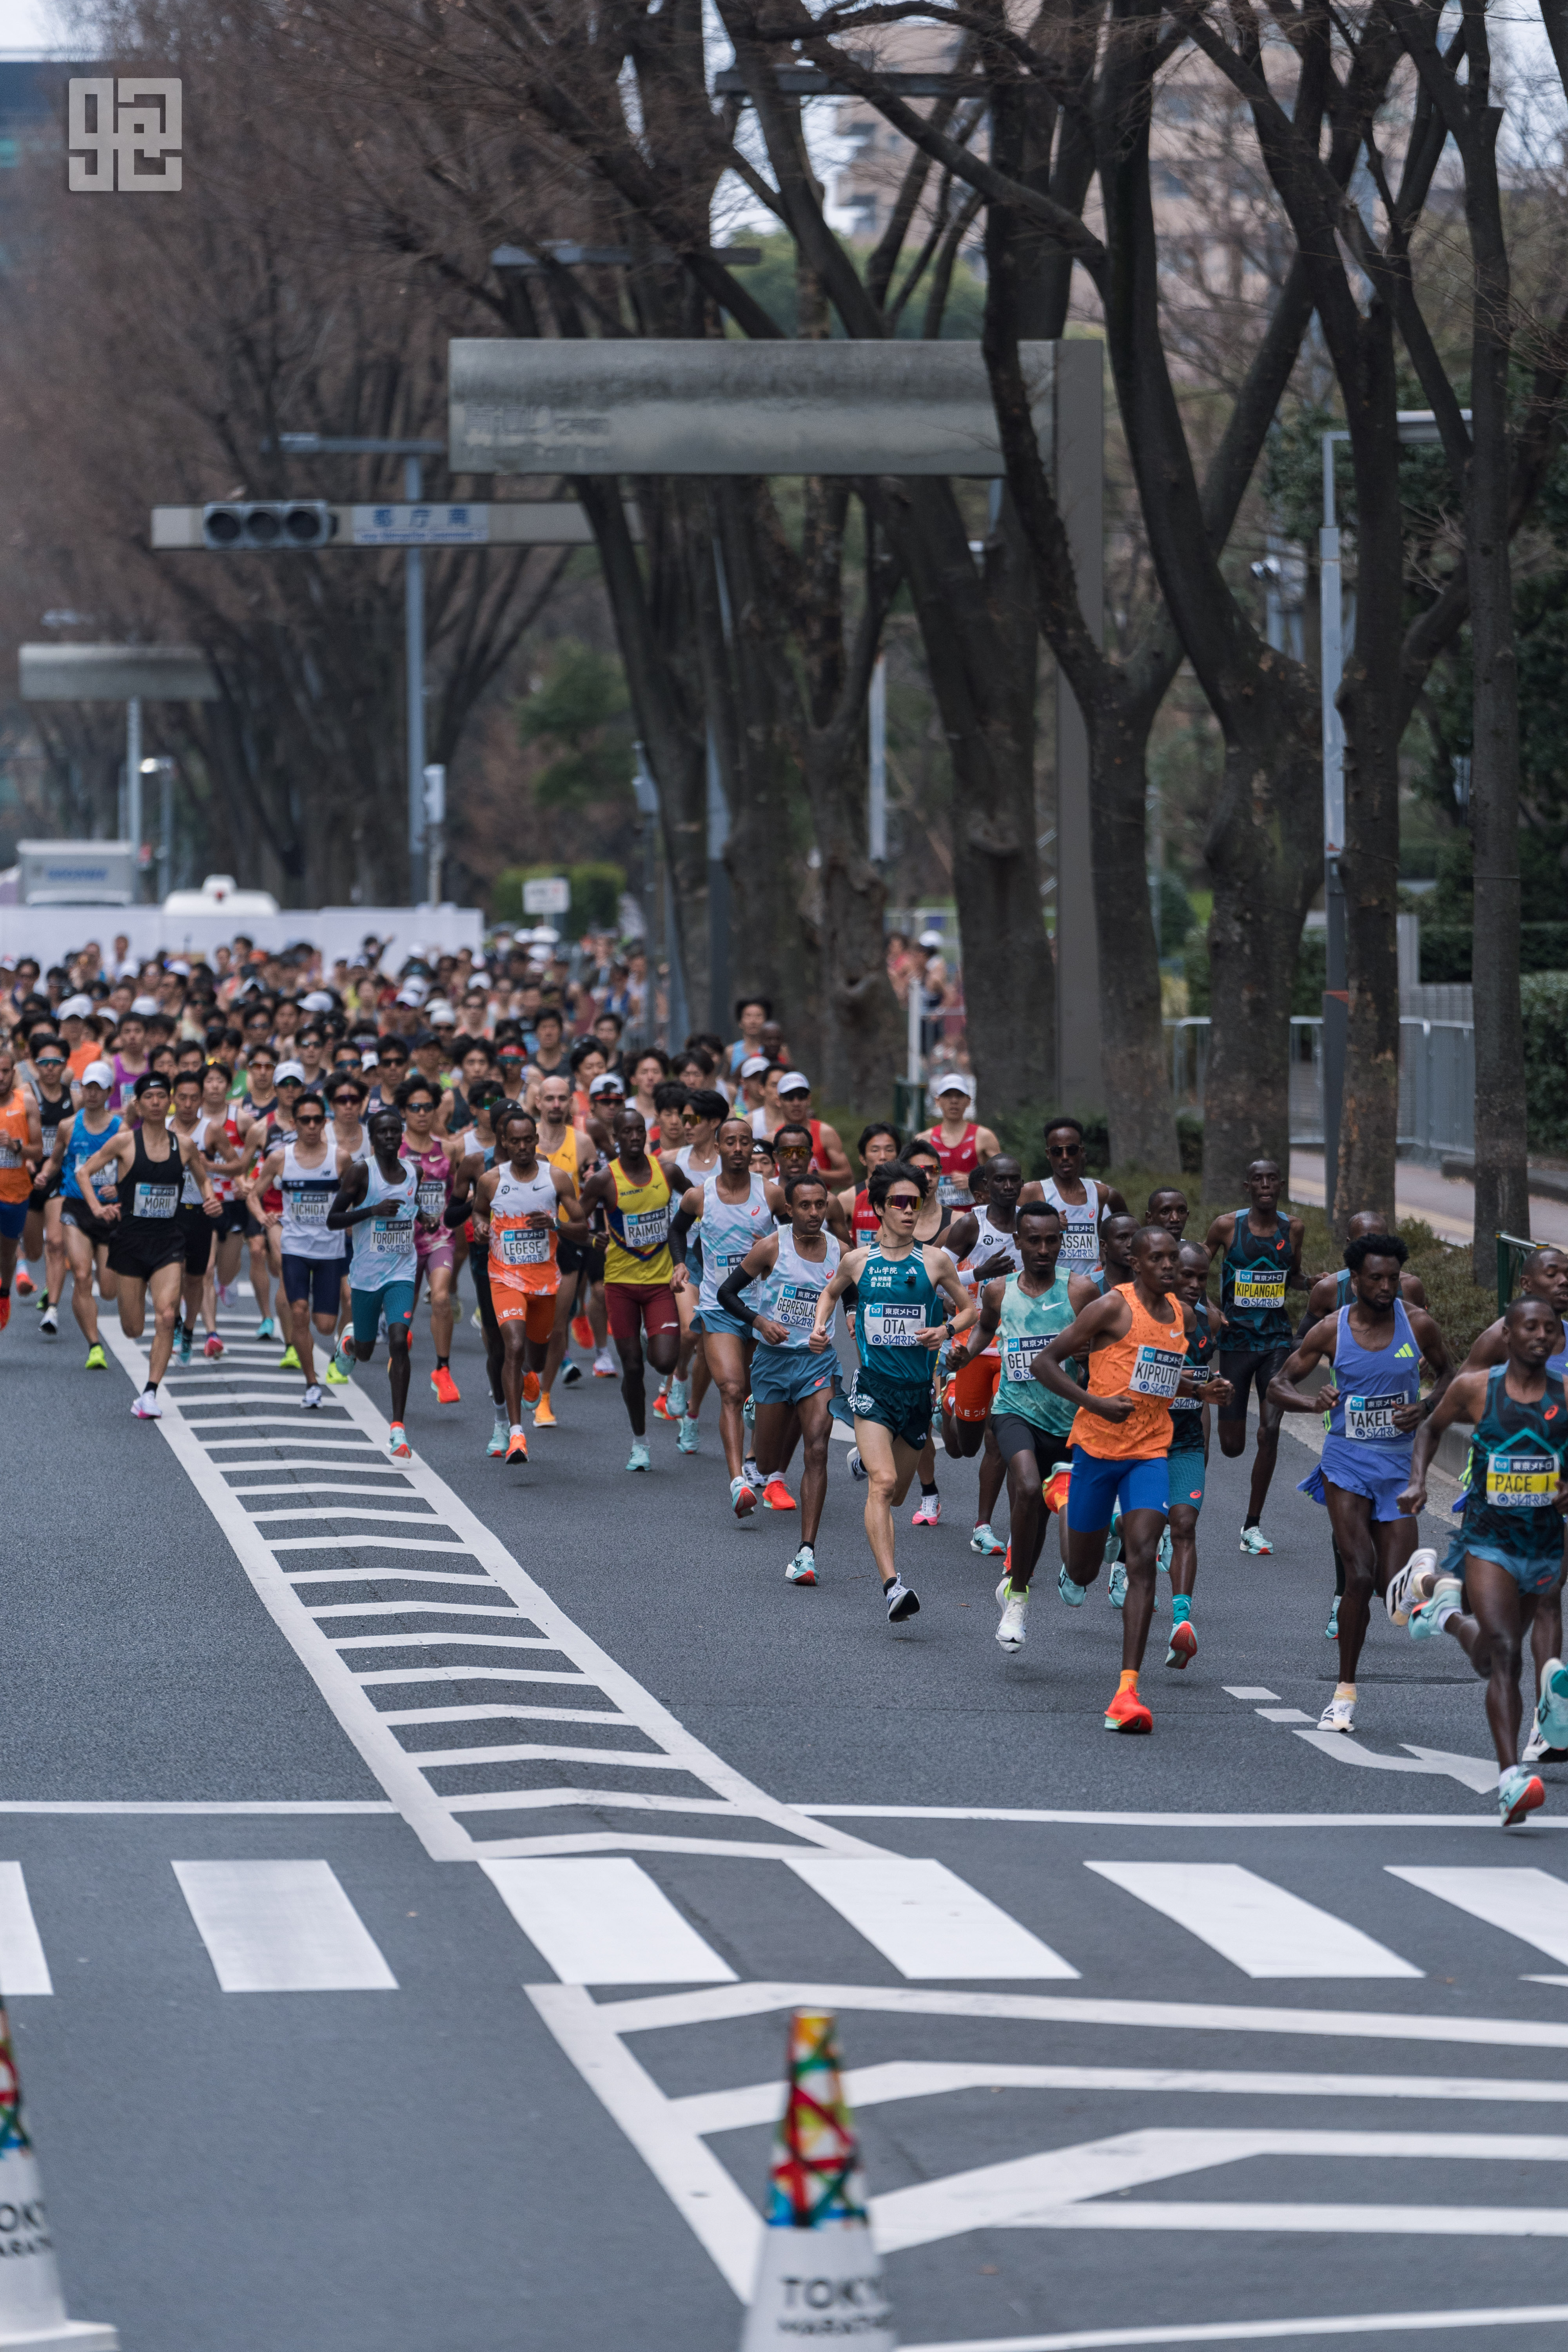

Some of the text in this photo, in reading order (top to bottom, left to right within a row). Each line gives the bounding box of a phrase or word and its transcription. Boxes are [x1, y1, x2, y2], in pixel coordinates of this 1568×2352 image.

[145, 1197, 170, 1209] MORII
[628, 1221, 663, 1238] RAIMOI
[372, 1232, 410, 1245] TOROITICH
[504, 1241, 541, 1256] LEGESE
[1067, 1249, 1094, 1258] STARTS
[517, 1254, 544, 1264] STARTS
[867, 1266, 898, 1275] 青山学院
[1236, 1283, 1279, 1298] KIPLANGAT
[1250, 1298, 1279, 1307] STARTS
[885, 1307, 919, 1316] 東京メトロ
[883, 1319, 906, 1334] OTA
[882, 1335, 916, 1345] STARTS
[1156, 1354, 1182, 1365] 東京メトロ
[1135, 1362, 1178, 1386] KIPRUTO
[1512, 1461, 1553, 1471] 東京メトロ
[1495, 1474, 1532, 1493] PACE
